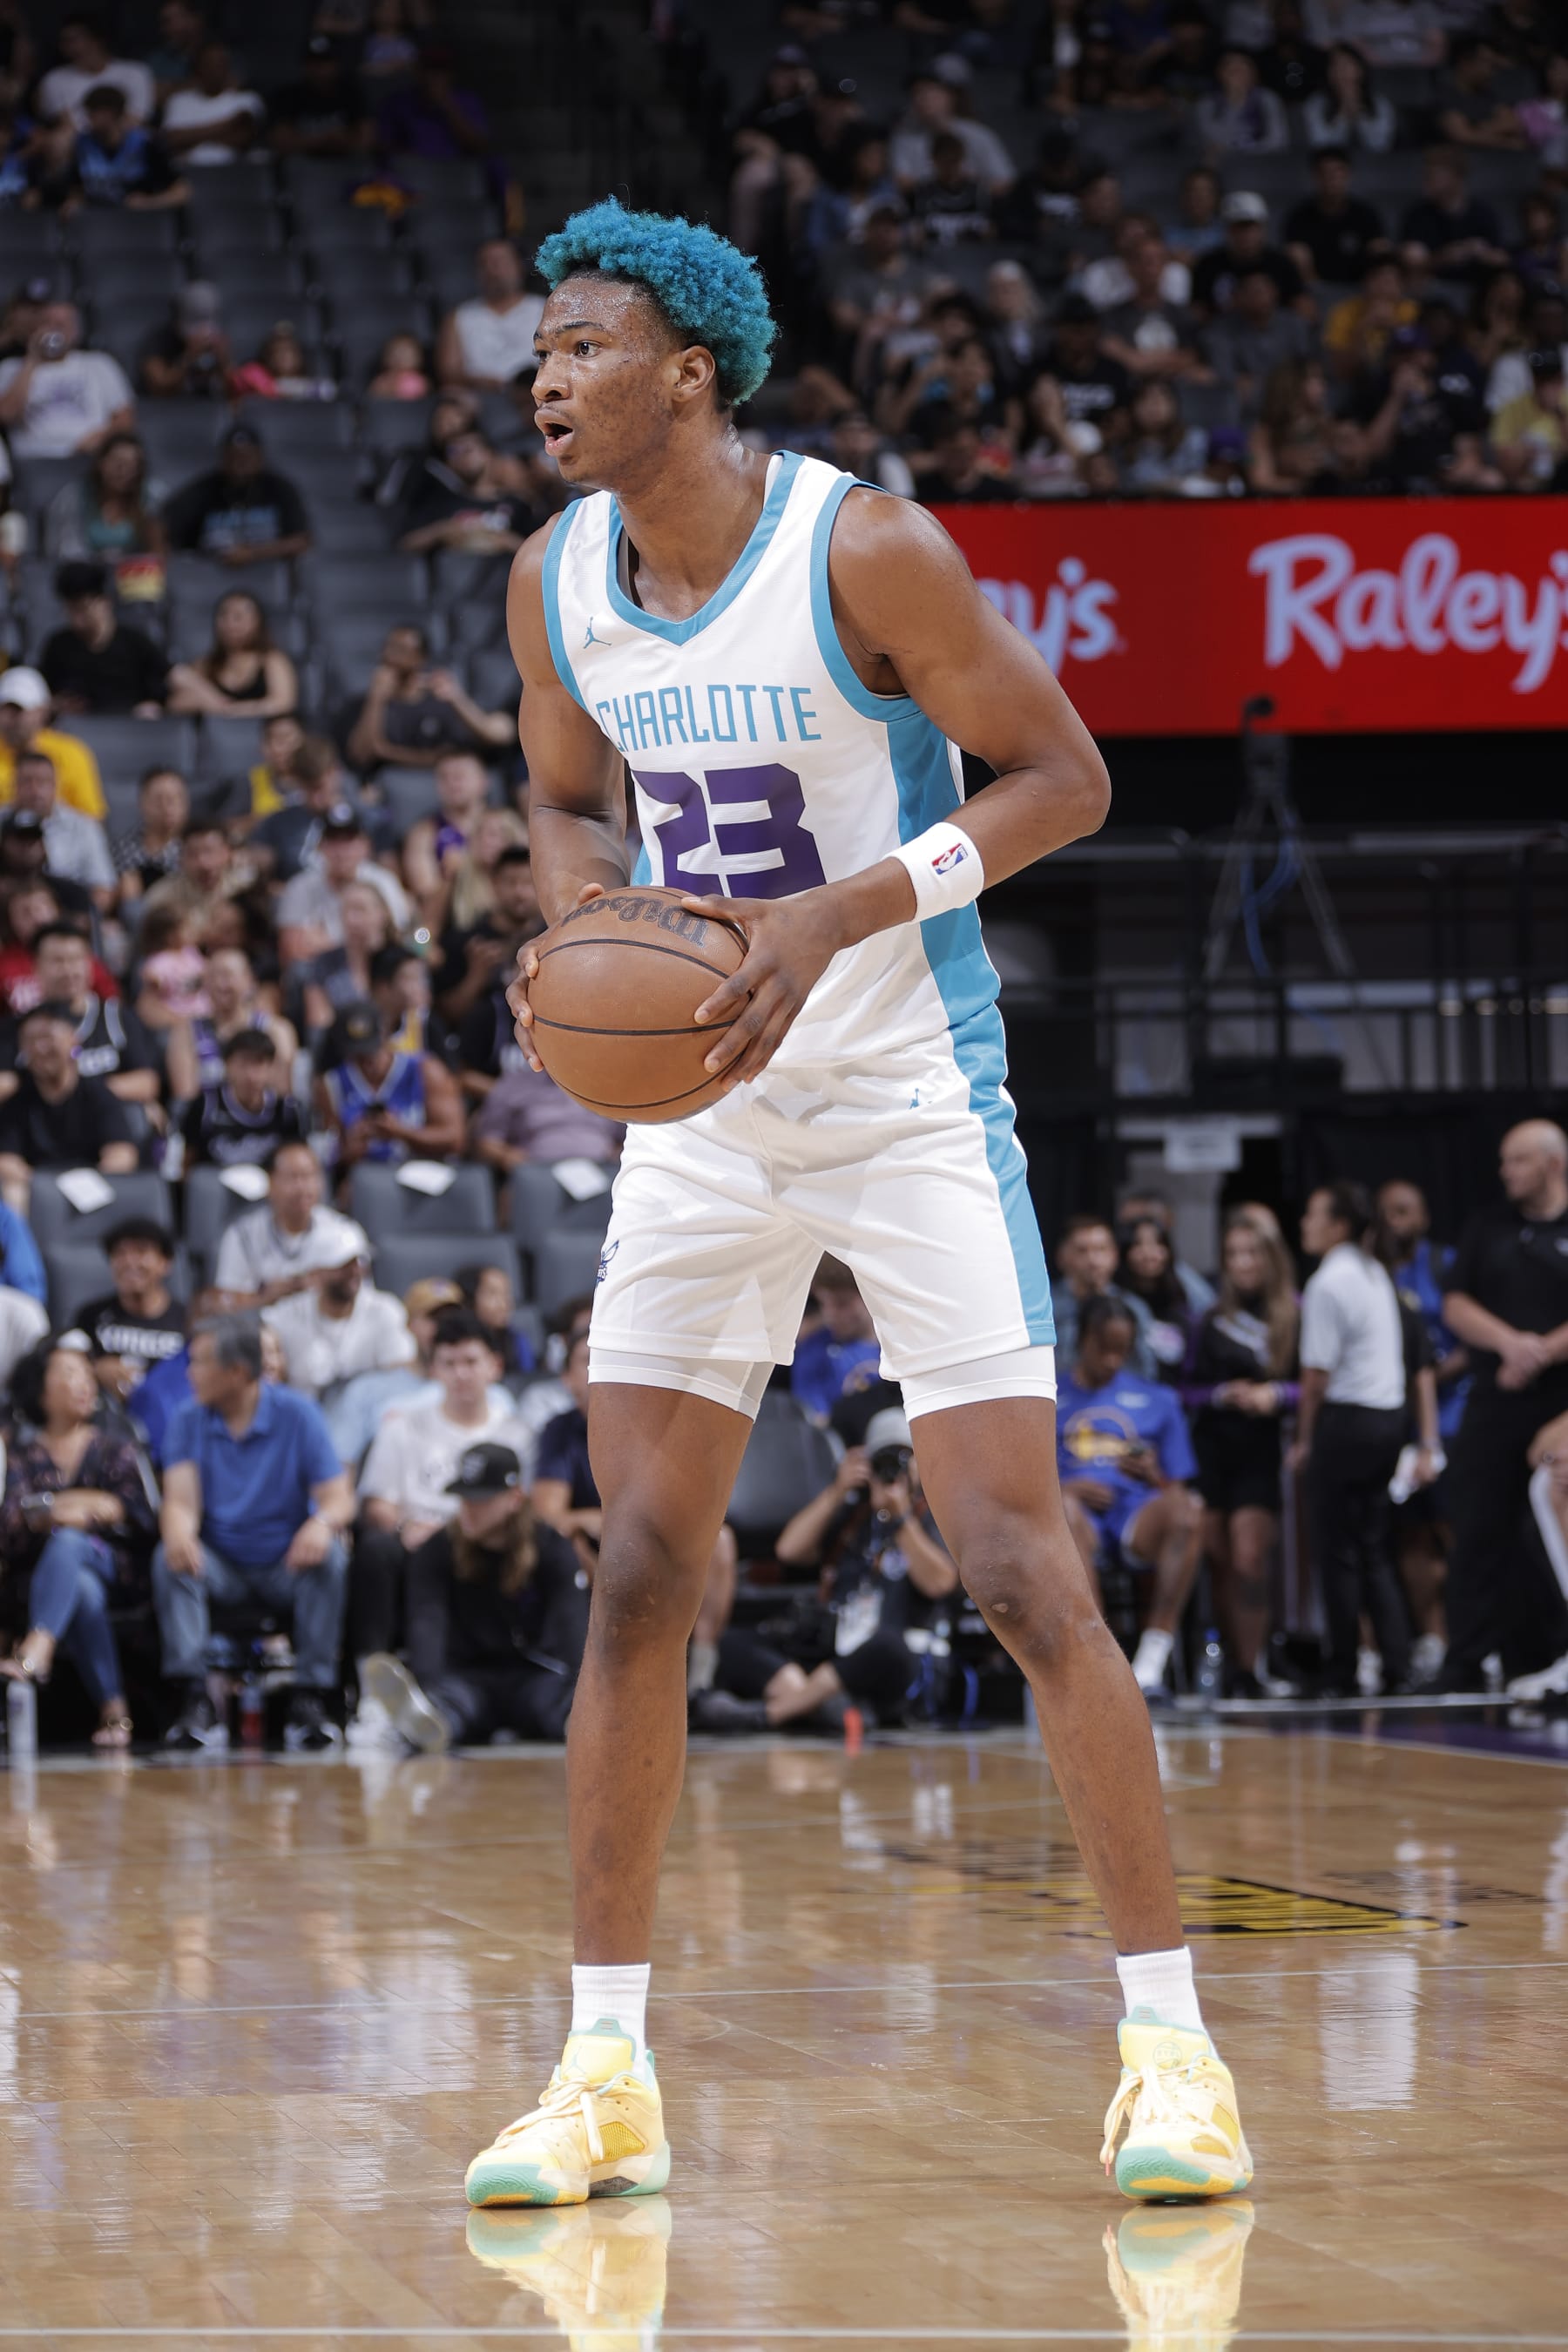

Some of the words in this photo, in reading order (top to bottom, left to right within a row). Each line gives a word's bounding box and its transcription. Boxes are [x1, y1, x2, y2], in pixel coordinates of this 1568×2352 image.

[1248, 531, 1568, 694] Raley'
[596, 685, 822, 753] CHARLOTTE
[632, 763, 828, 900] 23
